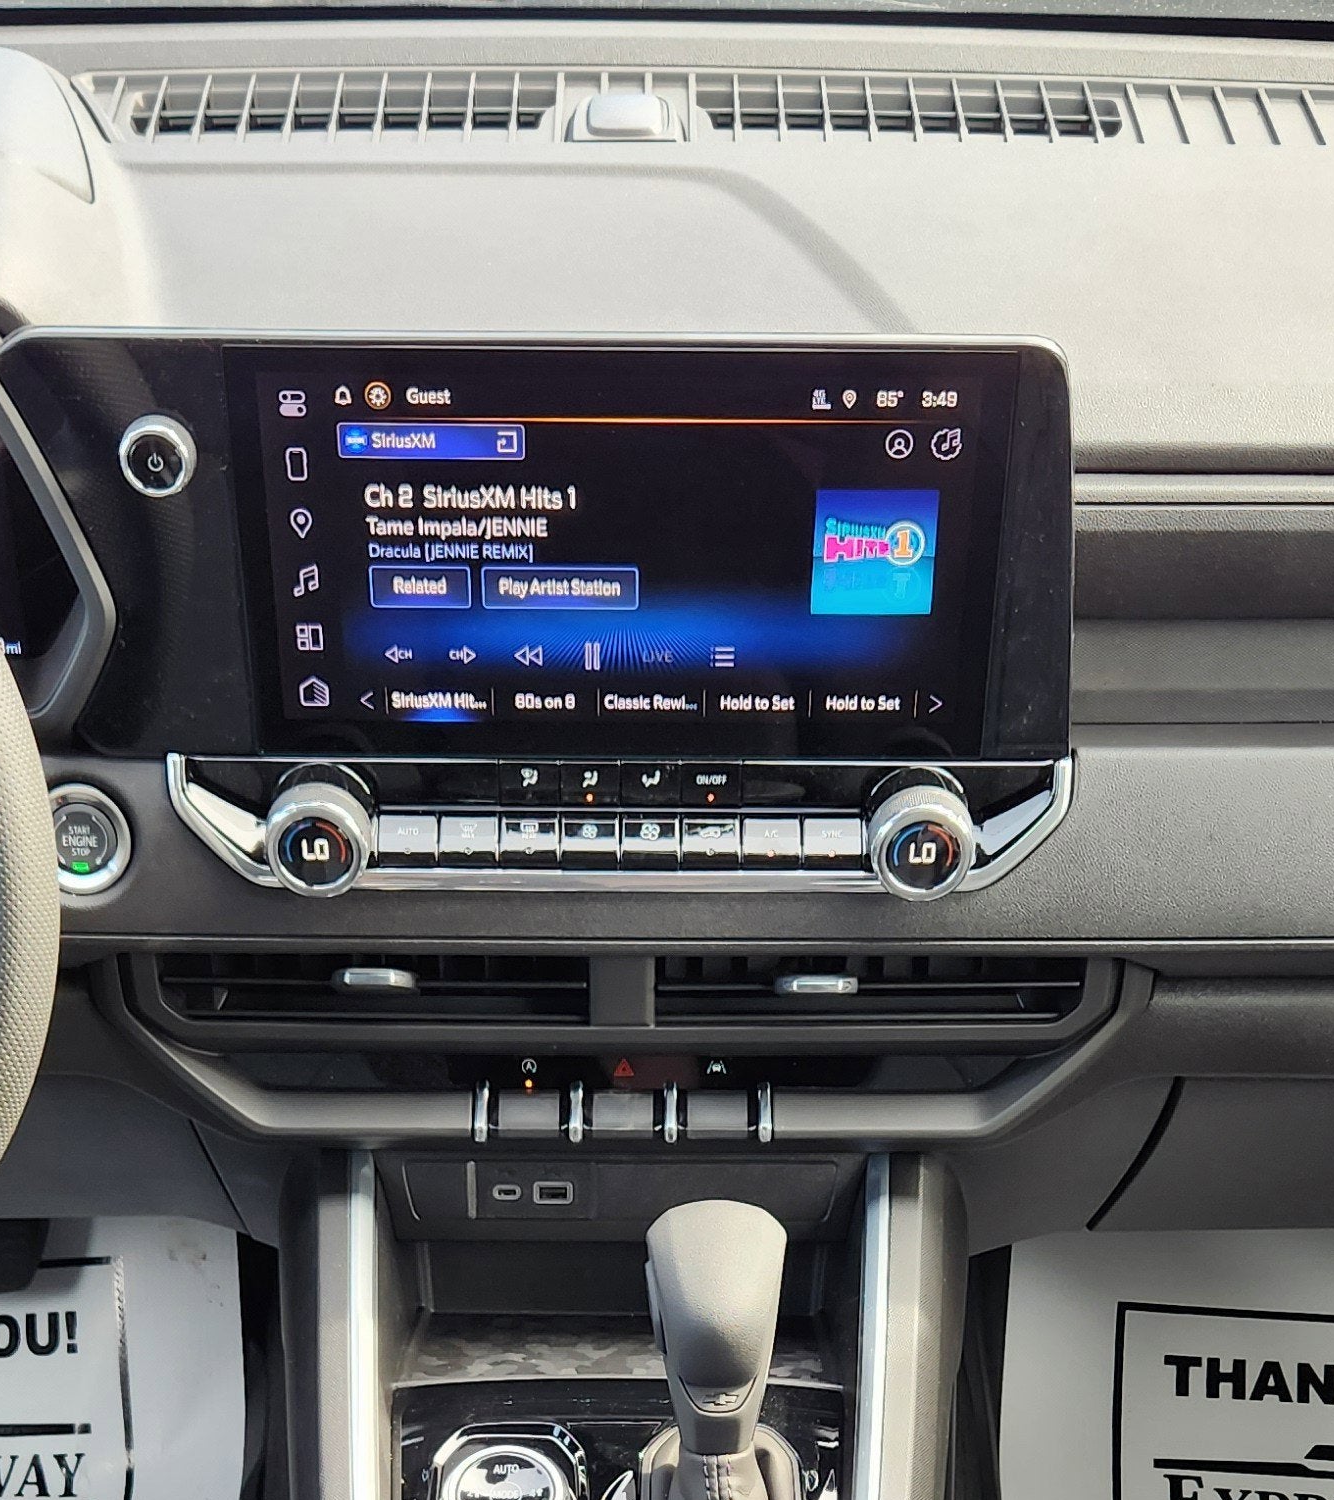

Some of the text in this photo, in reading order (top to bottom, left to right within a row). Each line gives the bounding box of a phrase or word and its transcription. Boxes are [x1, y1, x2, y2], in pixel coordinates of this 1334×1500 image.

[405, 387, 451, 405] Guest
[921, 391, 958, 408] 3:49
[371, 432, 436, 449] SiriusXM
[364, 483, 393, 509] Ch
[423, 484, 516, 510] SiriusXM
[521, 484, 563, 510] Hits
[567, 485, 576, 509] 1
[365, 515, 548, 540] Tame Impala/JENNIE
[894, 530, 912, 557] 1
[369, 543, 421, 559] Dracula
[482, 543, 534, 563] REMIX]
[393, 575, 447, 595] Related
[498, 577, 621, 598] Play Artist Station
[398, 649, 412, 660] CH
[449, 650, 463, 660] CH
[643, 651, 674, 663] LIVE
[391, 691, 452, 710] SiriusXM
[545, 696, 562, 709] on
[604, 693, 650, 710] Classic
[720, 694, 795, 711] Hold to Set
[825, 695, 901, 712] Hold to Set
[695, 774, 727, 787] ON/OFF
[68, 825, 91, 835] START
[397, 827, 420, 836] AUTO
[821, 829, 843, 839] SYNC
[62, 834, 99, 848] ENGINE
[71, 848, 91, 857] STOP
[493, 1464, 520, 1474] AUTO
